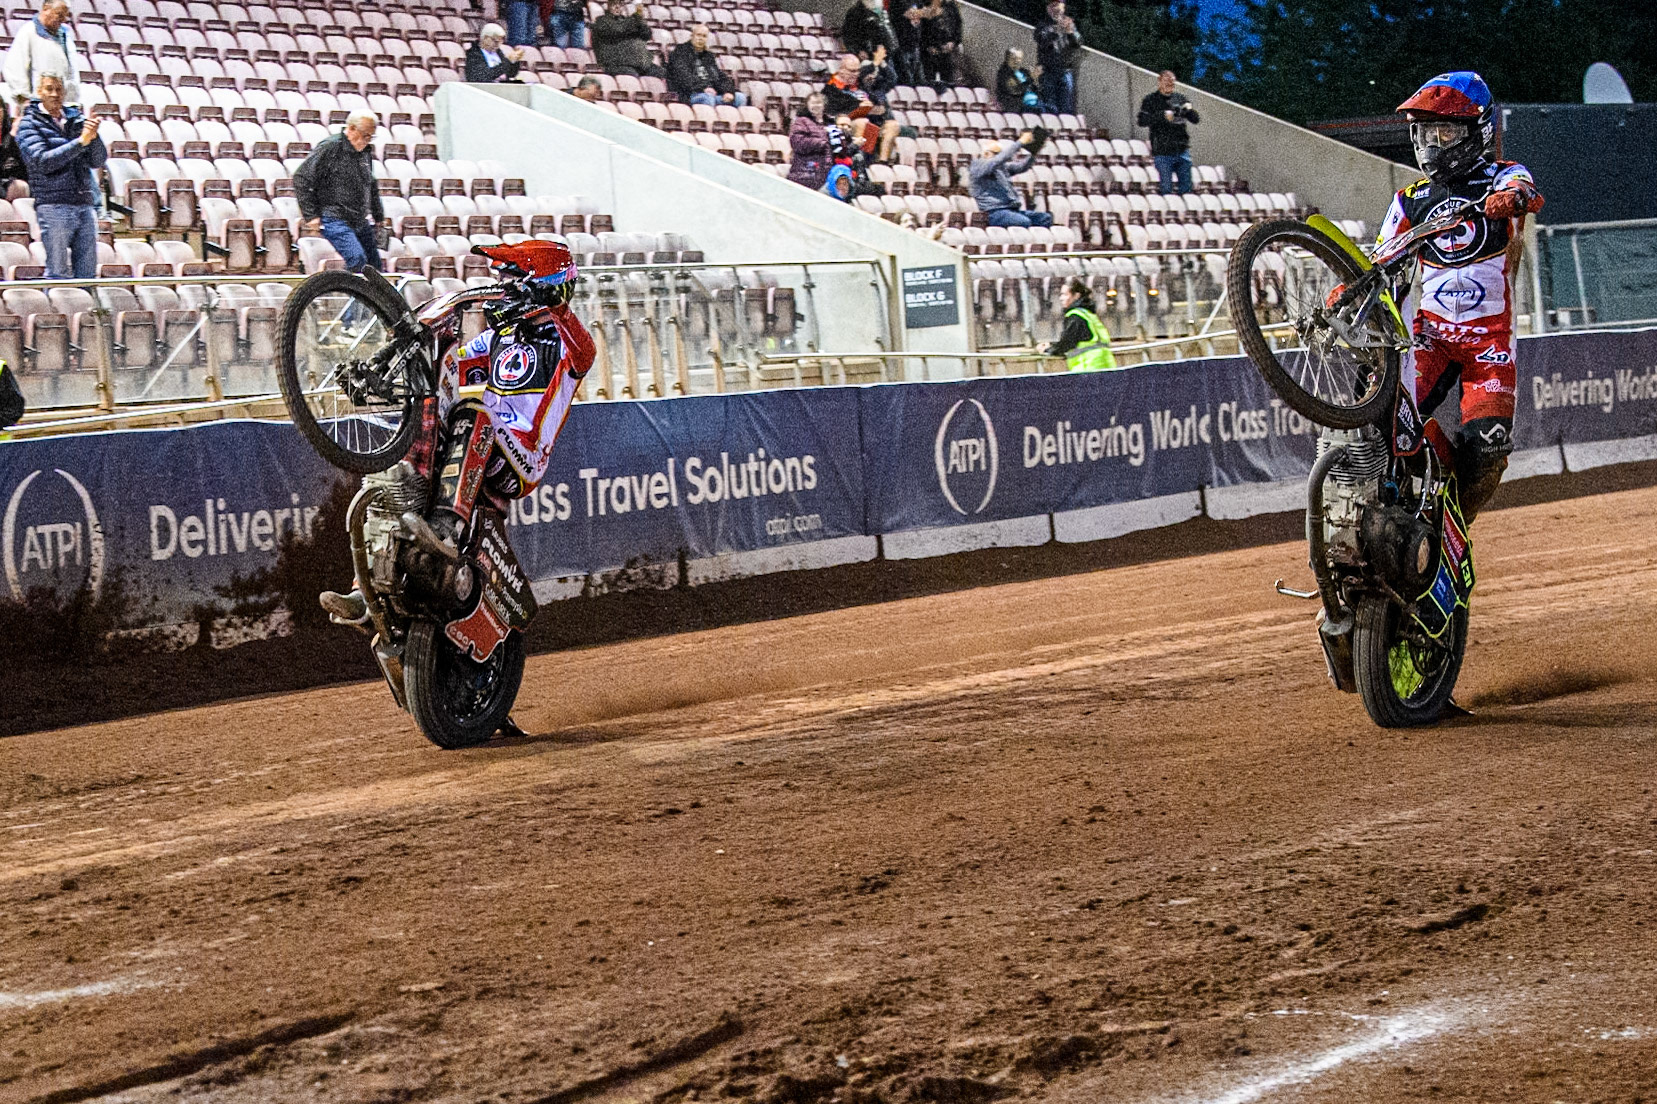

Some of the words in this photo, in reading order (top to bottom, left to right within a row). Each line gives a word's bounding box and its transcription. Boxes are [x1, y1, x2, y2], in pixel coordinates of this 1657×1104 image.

[903, 271, 935, 281] BLOCK
[935, 269, 943, 279] F
[905, 292, 936, 303] BLOCK
[1533, 370, 1614, 413] Delivering
[948, 437, 986, 474] ATPI
[1023, 415, 1145, 467] Delivering
[1218, 401, 1269, 442] Class
[504, 482, 571, 527] lass
[579, 457, 679, 517] Travel
[684, 448, 818, 505] Solutions
[22, 522, 82, 572] ATPI
